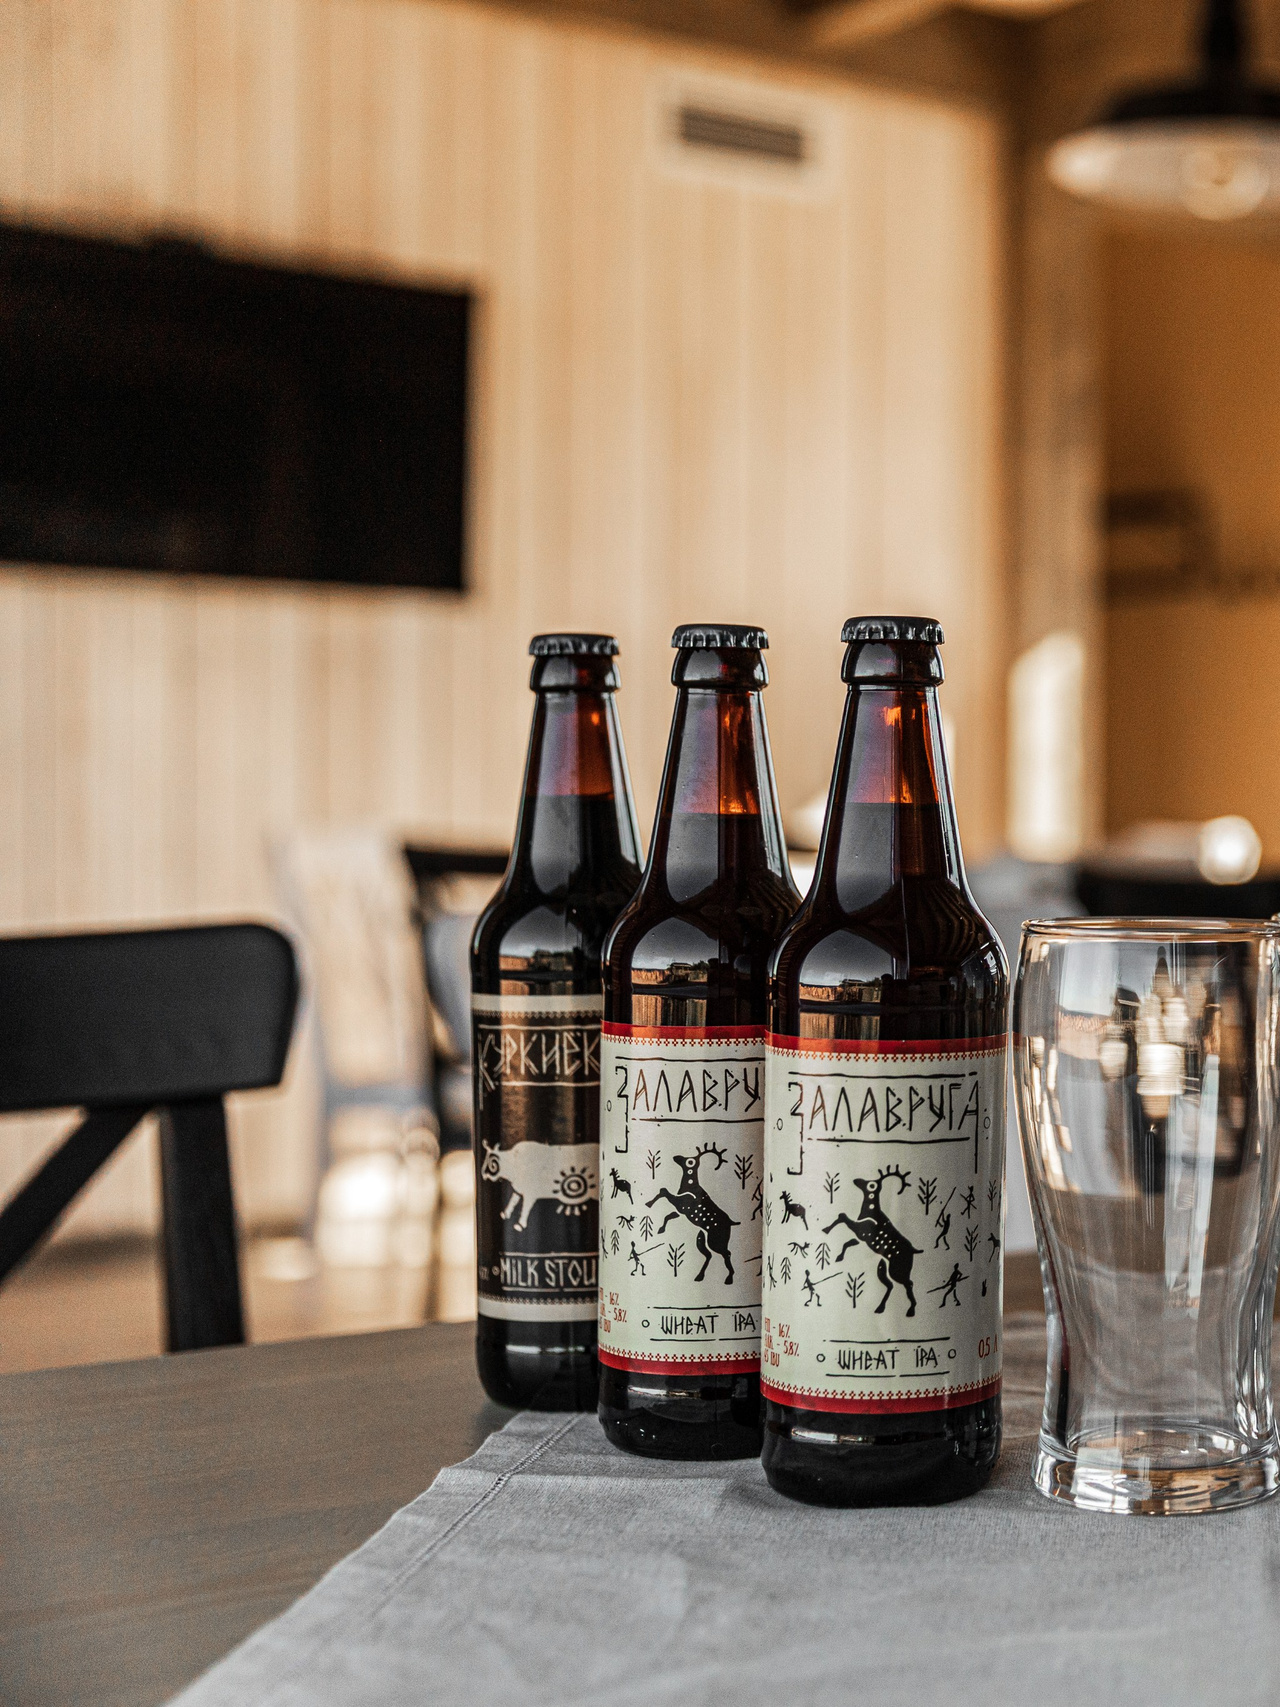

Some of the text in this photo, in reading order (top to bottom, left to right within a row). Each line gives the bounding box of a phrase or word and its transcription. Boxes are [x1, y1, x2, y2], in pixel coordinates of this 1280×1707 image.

[615, 1066, 761, 1152] ЗАЛАВРУ
[500, 1257, 539, 1286] MILK
[544, 1258, 597, 1287] STOU
[661, 1311, 757, 1335] WHEAT IPA
[838, 1345, 940, 1371] WHEAT IPA
